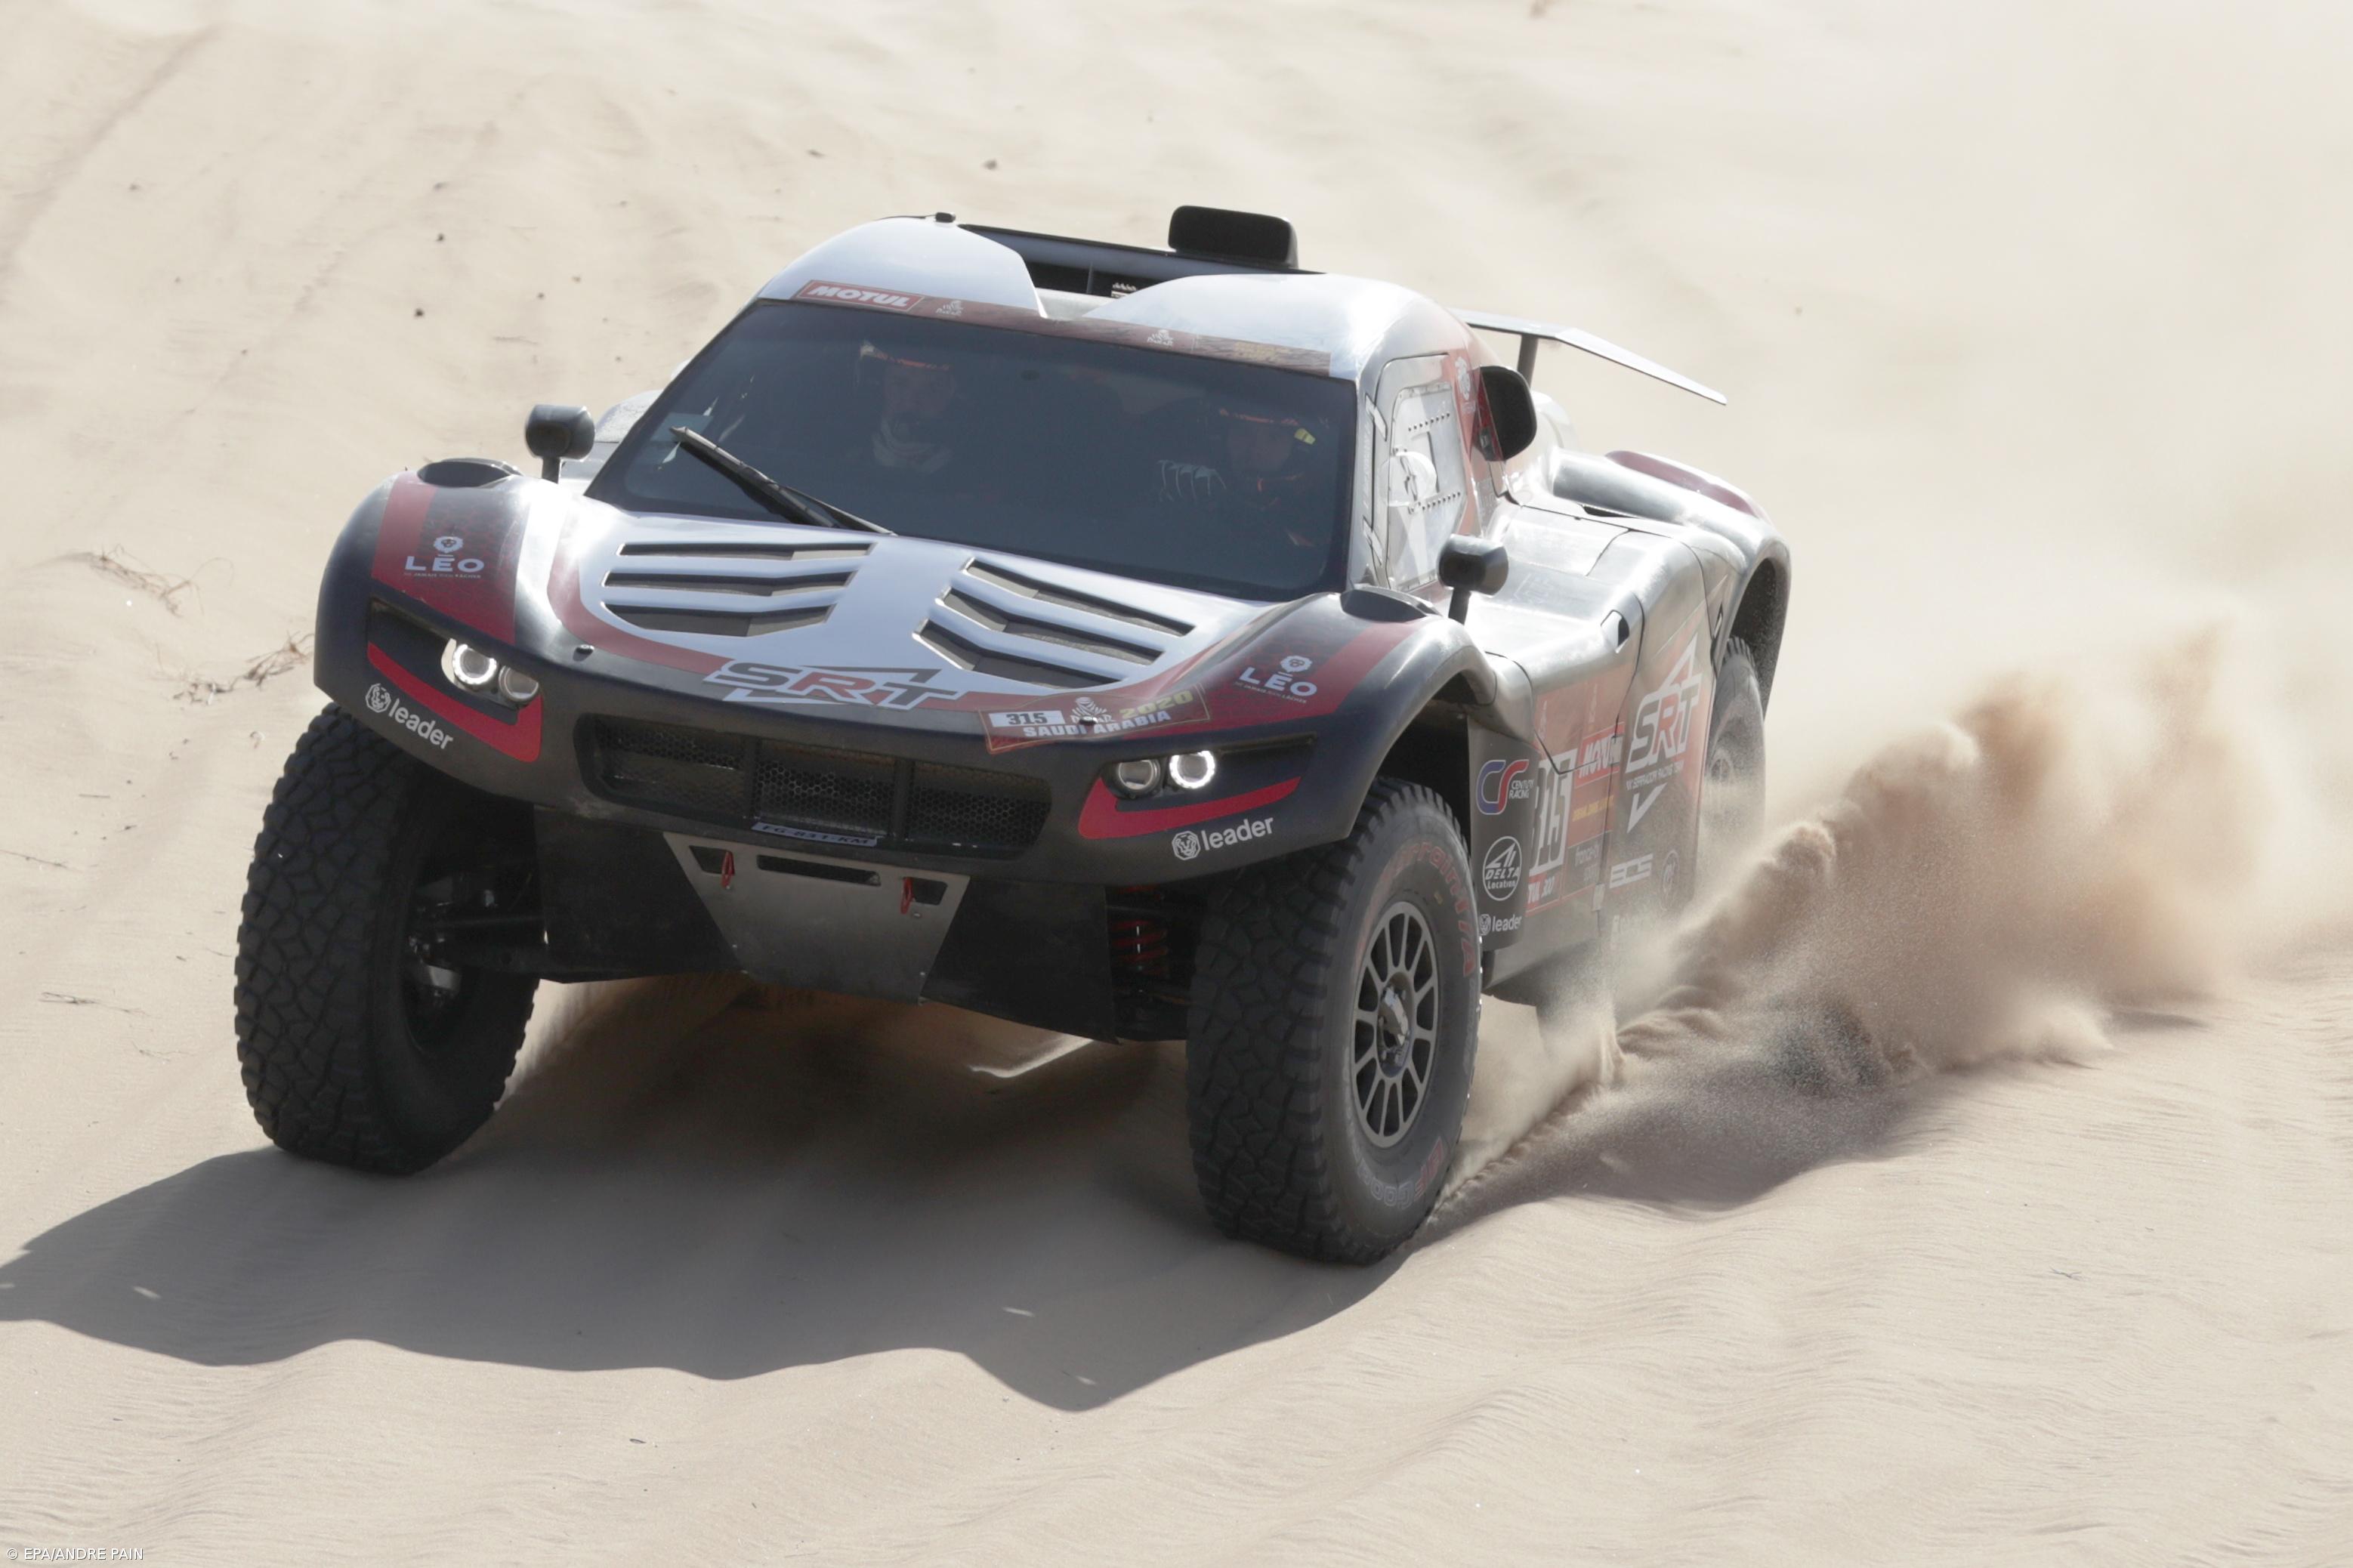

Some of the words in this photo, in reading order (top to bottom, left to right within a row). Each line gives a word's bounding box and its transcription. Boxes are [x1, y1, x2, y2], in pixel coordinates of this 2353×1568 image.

[807, 286, 910, 307] MOTUL
[706, 661, 959, 708] SRT
[1119, 690, 1194, 718] 2020
[388, 698, 453, 749] leader
[1006, 712, 1048, 726] 315
[1024, 724, 1088, 737] SAUDI
[1093, 711, 1171, 734] ARABIA
[1626, 672, 1703, 773] SRT
[1203, 816, 1274, 852] leader
[1485, 866, 1521, 880] DELTA
[1487, 880, 1516, 890] Location
[1492, 914, 1522, 932] leader
